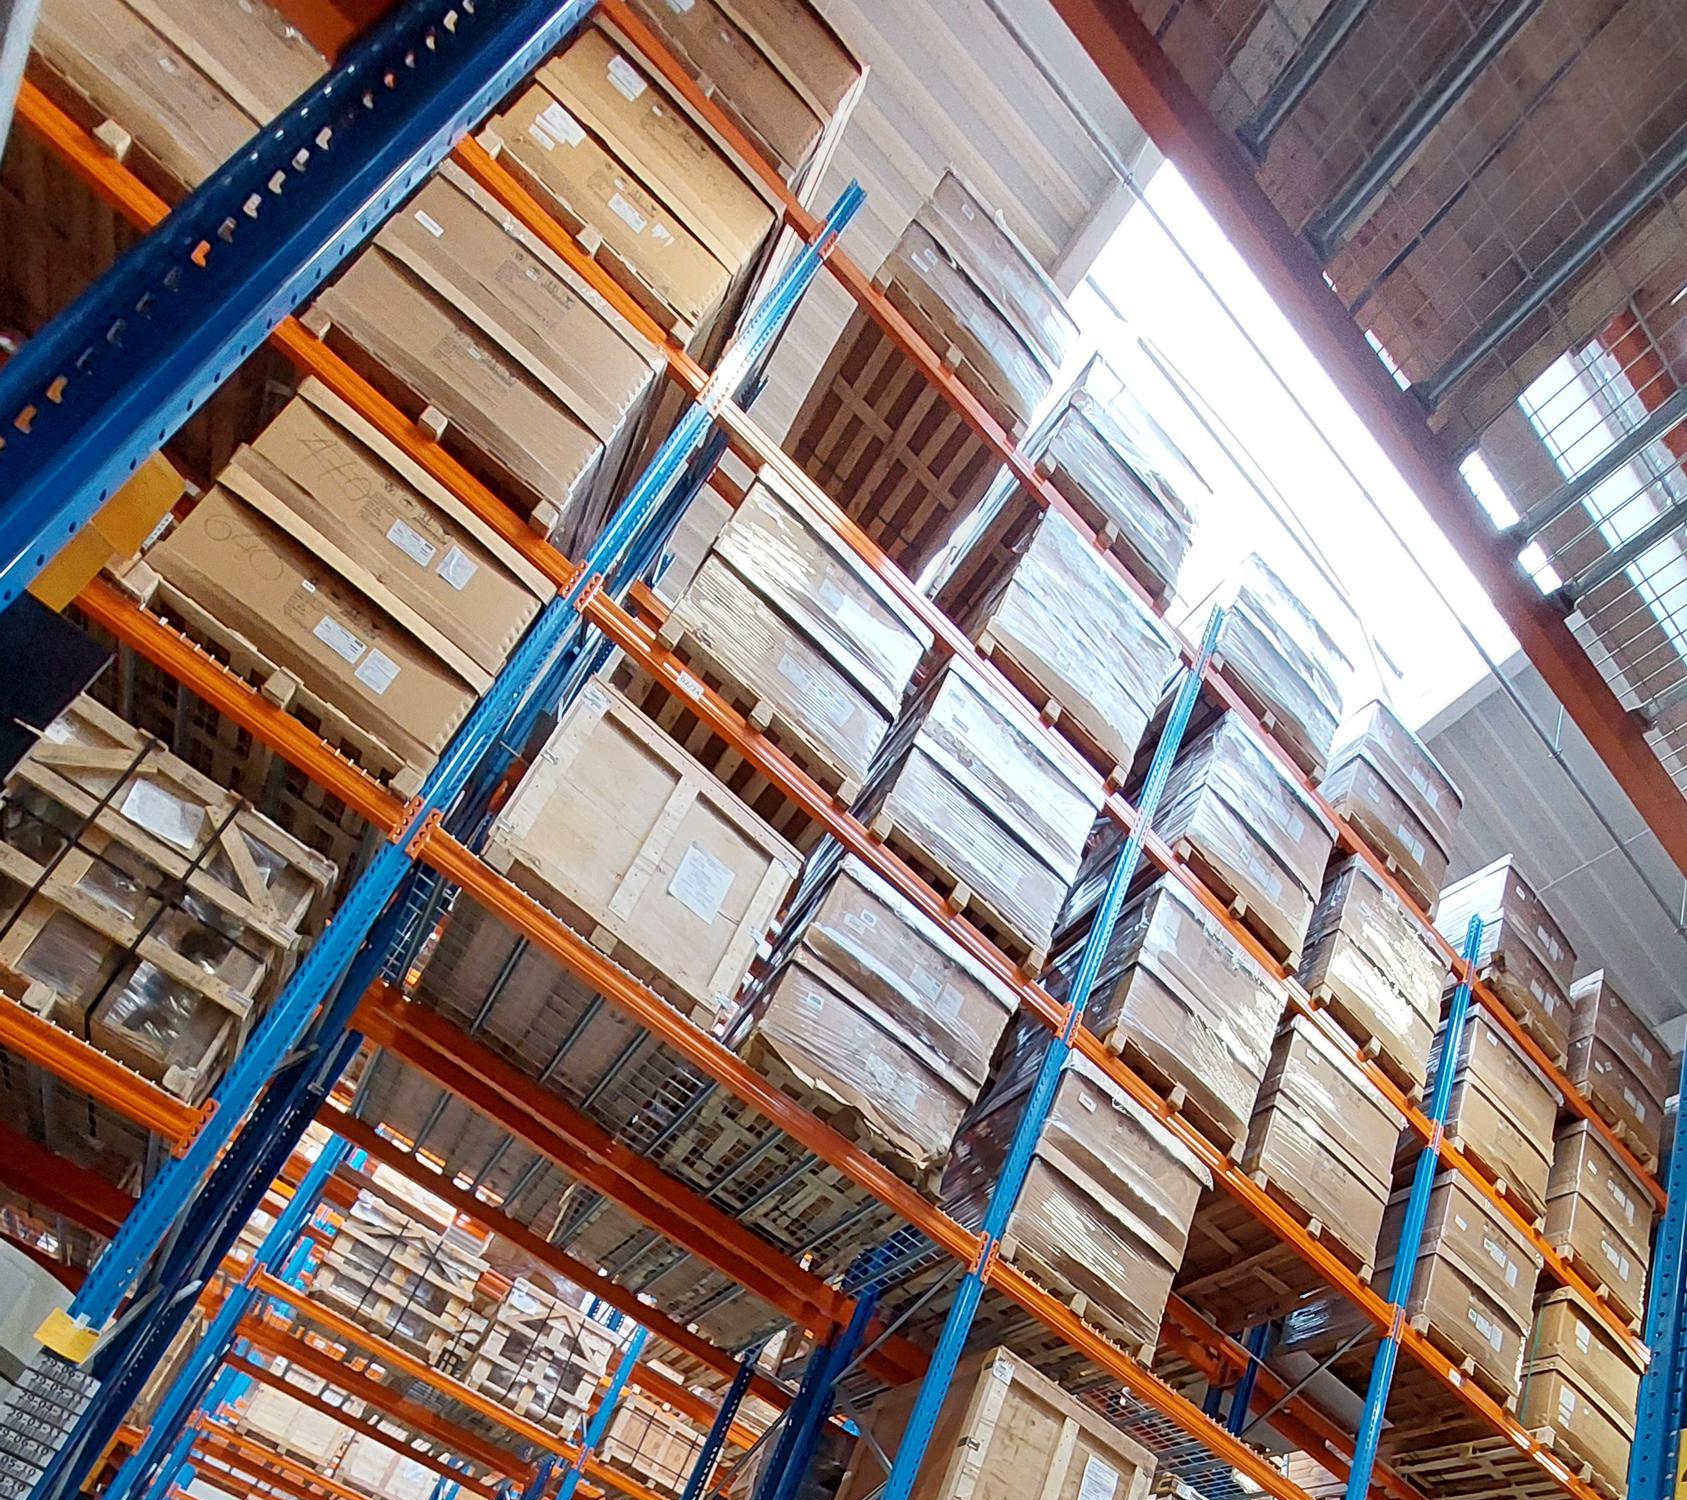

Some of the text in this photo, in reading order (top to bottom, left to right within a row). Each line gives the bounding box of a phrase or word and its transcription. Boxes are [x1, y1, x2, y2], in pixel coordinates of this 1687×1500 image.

[30, 1373, 83, 1403] 29-05-11
[19, 1390, 71, 1421] 29-04-11
[8, 1408, 60, 1438] 29-03-11
[0, 1426, 49, 1456] 9-06-10
